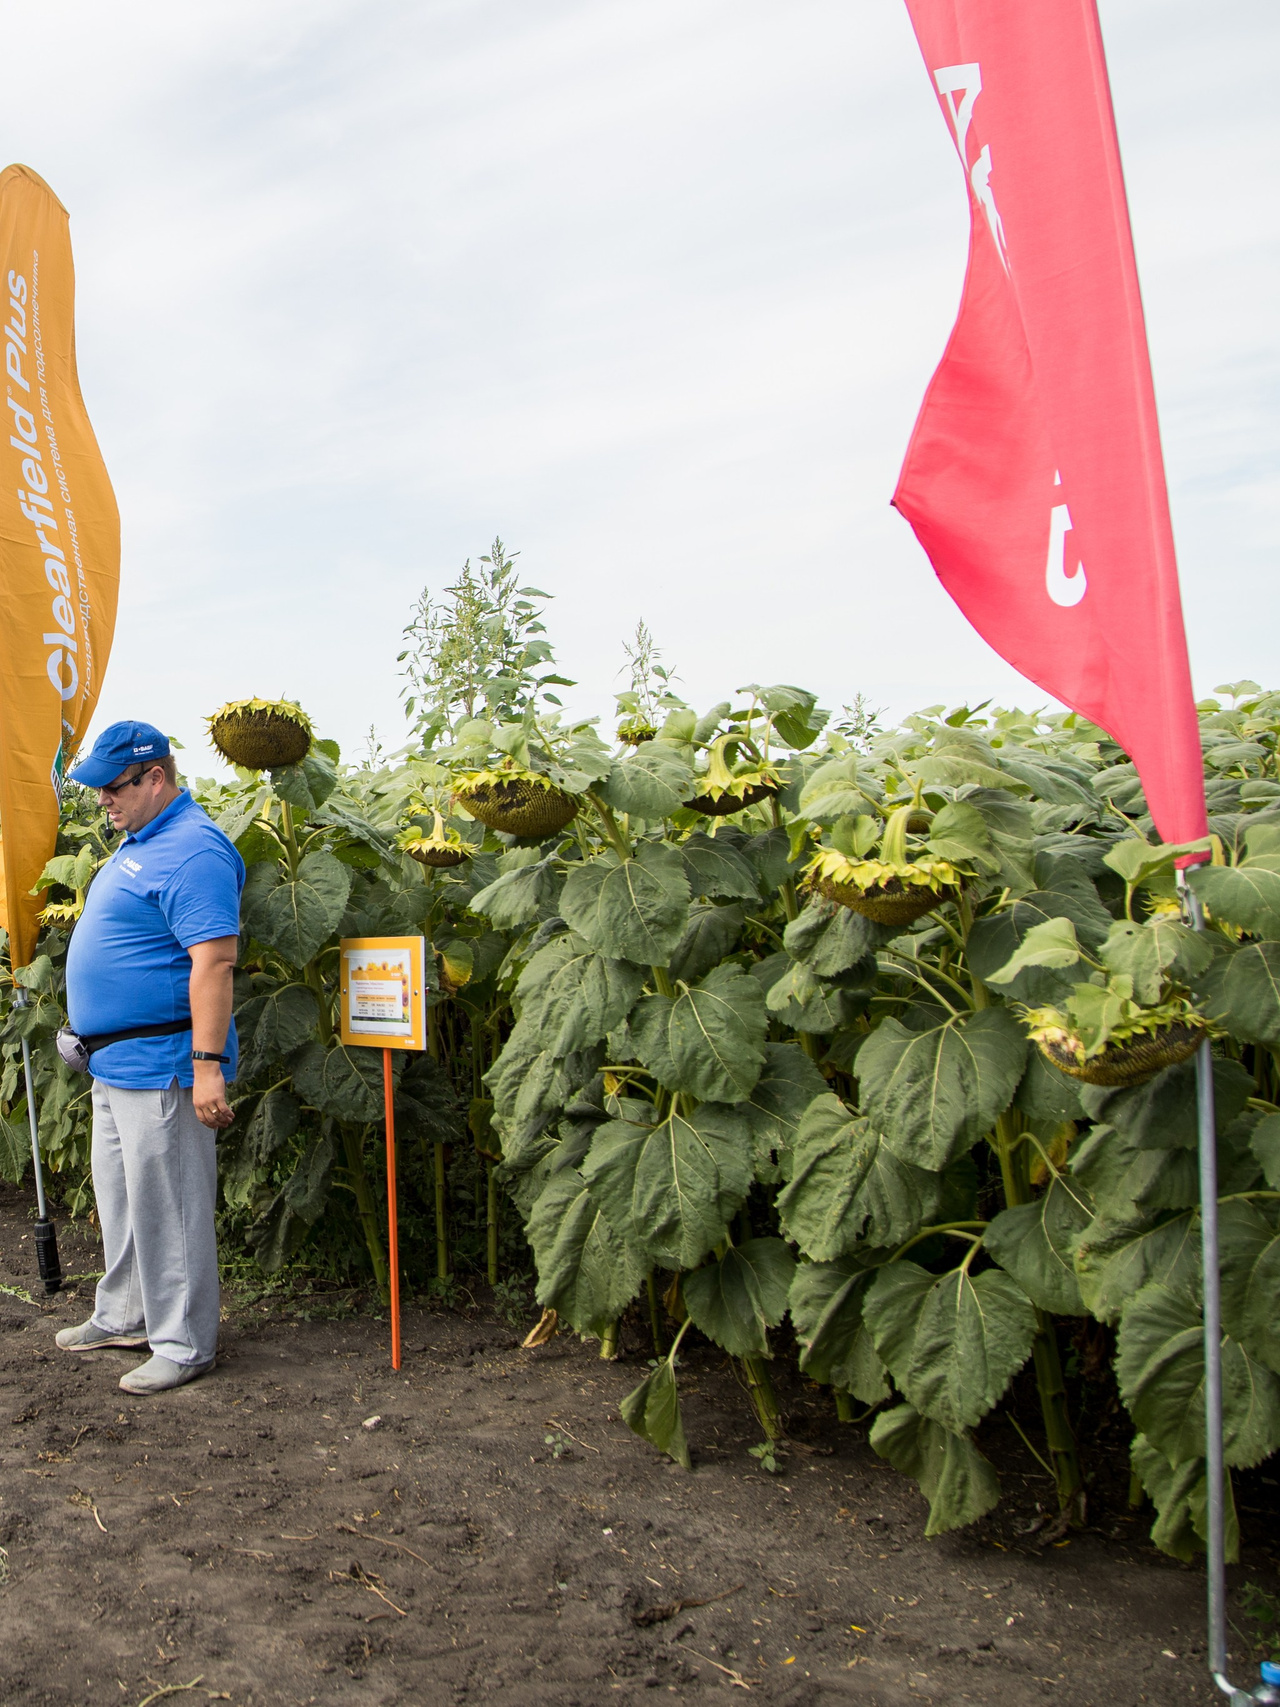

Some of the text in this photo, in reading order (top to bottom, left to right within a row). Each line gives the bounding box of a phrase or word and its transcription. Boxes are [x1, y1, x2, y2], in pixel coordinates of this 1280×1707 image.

[4, 269, 31, 393] Plus
[31, 249, 47, 384] подсолнечника
[37, 386, 54, 424] для
[44, 425, 71, 503] система
